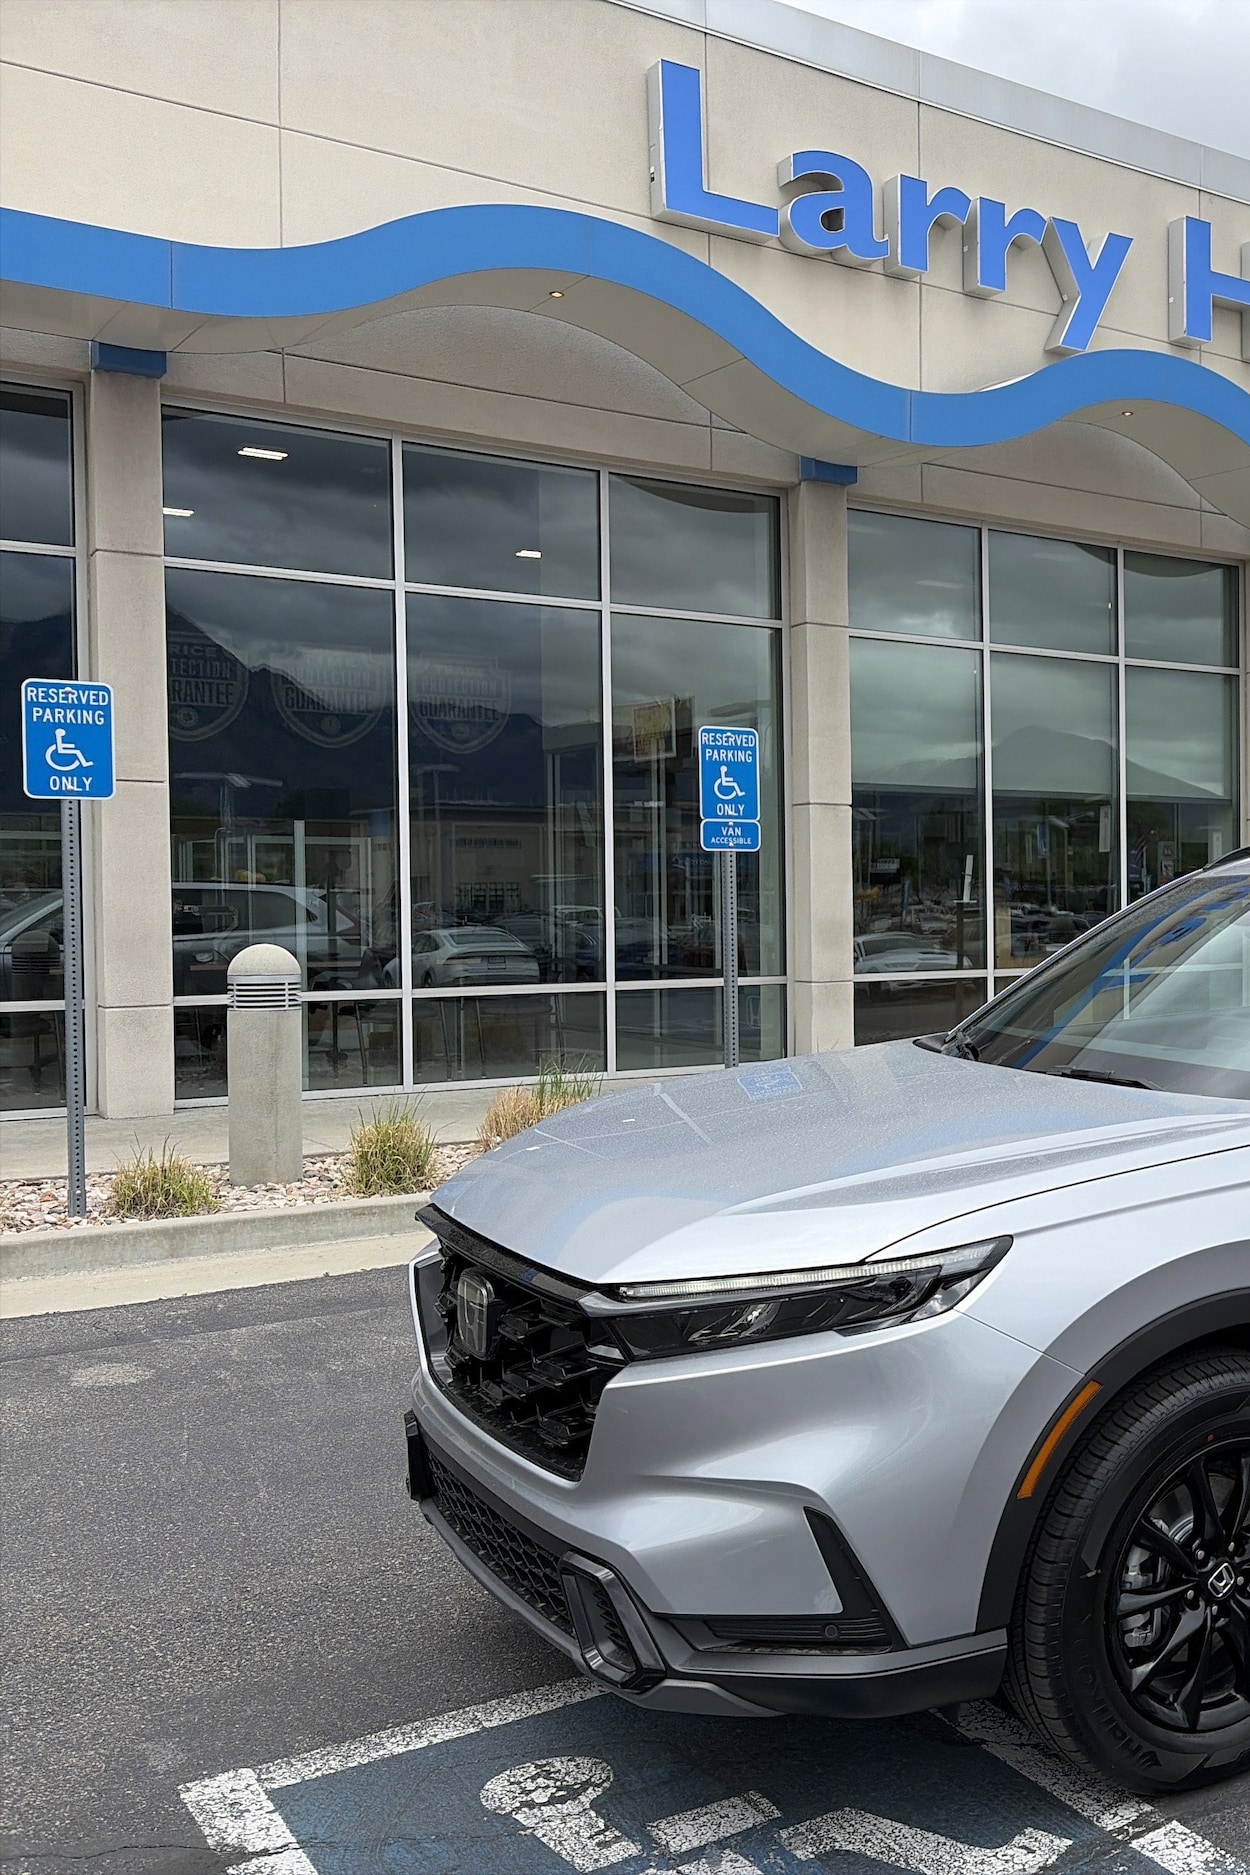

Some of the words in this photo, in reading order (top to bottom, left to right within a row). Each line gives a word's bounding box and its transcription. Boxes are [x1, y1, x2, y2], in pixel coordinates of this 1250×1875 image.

[650, 56, 1133, 353] Larry
[170, 658, 230, 678] TECTION
[27, 687, 109, 706] RESERVED
[171, 679, 234, 704] RANTEE
[32, 707, 105, 725] PARKING
[701, 733, 755, 747] RESERVED
[705, 749, 753, 763] PARKING
[49, 776, 93, 792] ONLY
[716, 803, 745, 816] ONLY
[721, 827, 742, 837] VAN
[710, 837, 752, 845] ACCESSIBLE
